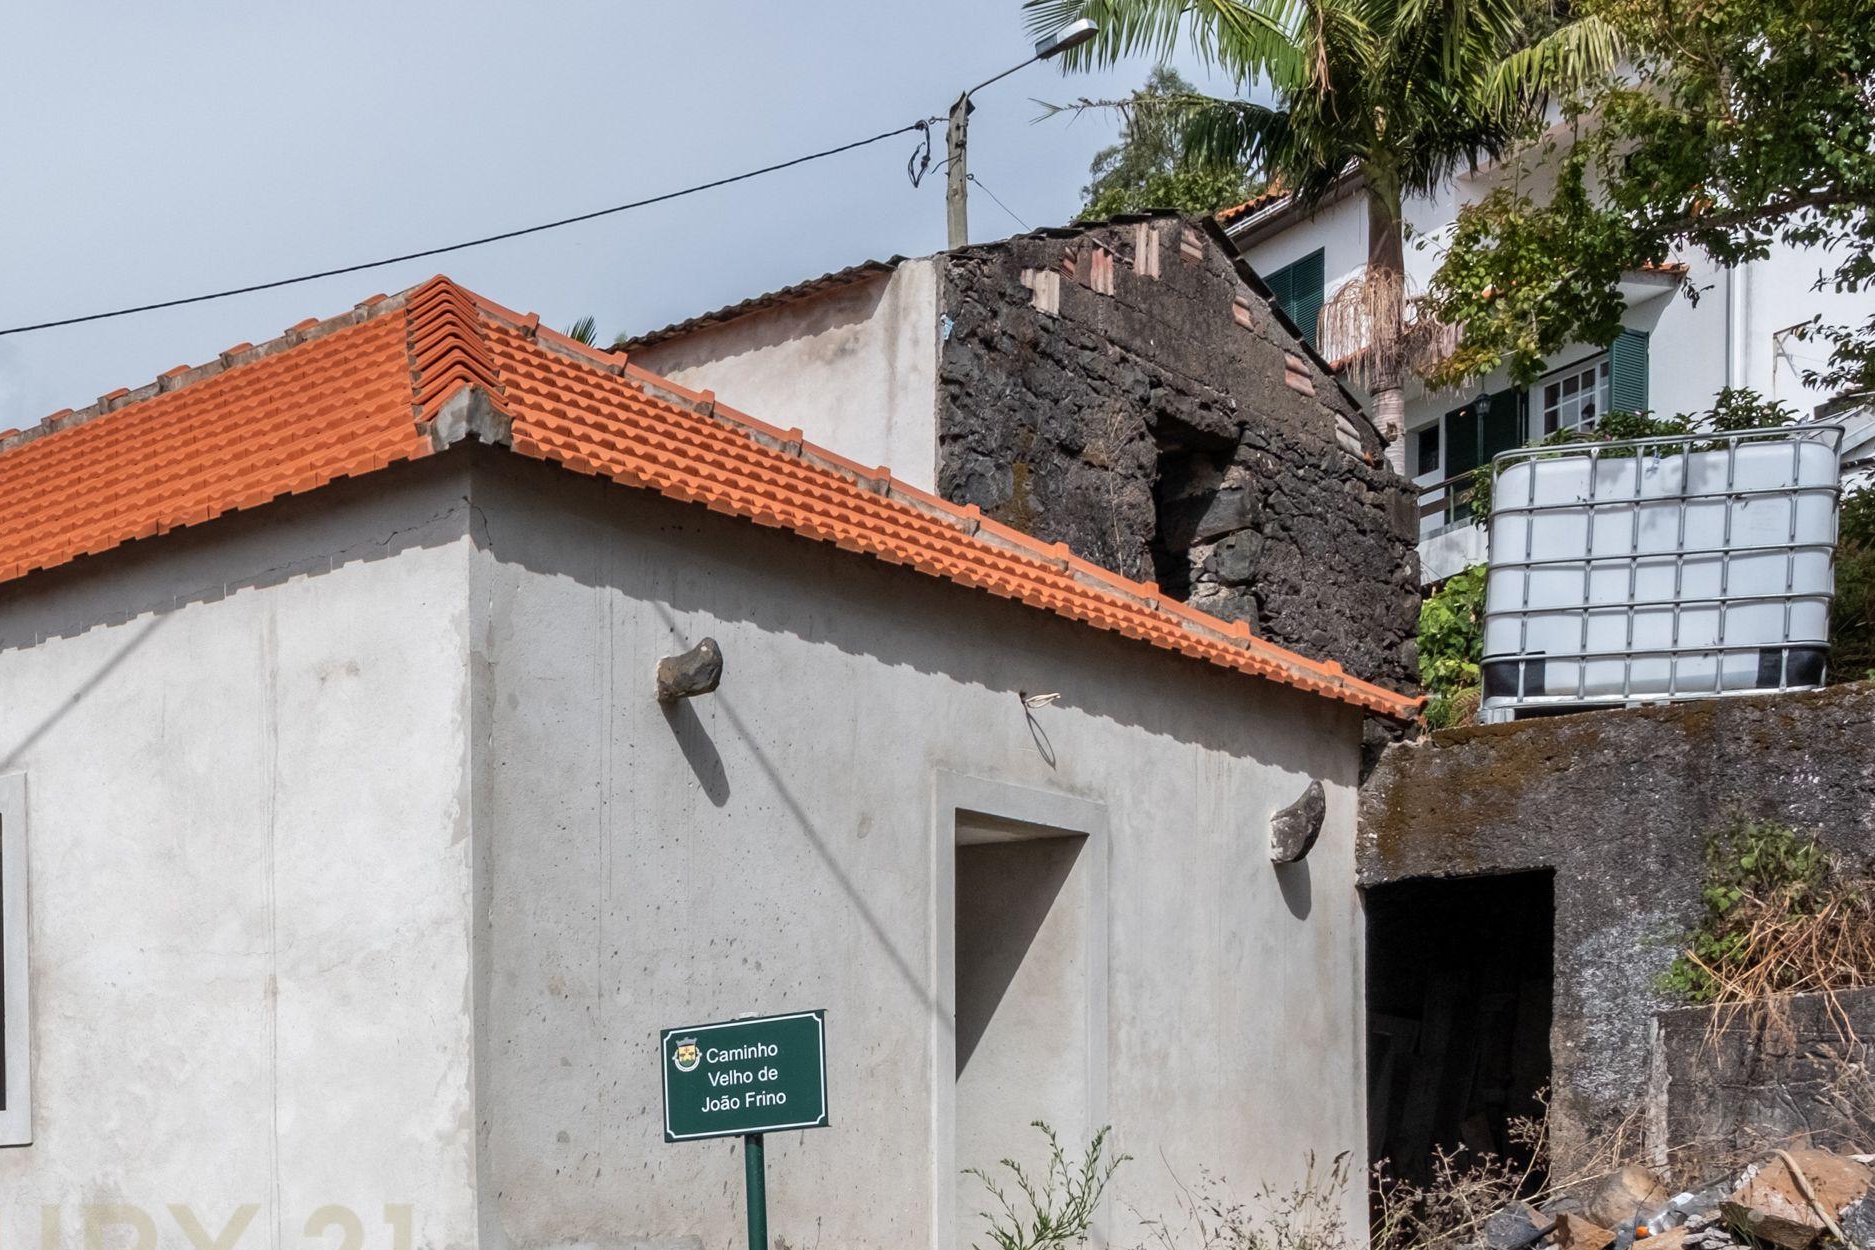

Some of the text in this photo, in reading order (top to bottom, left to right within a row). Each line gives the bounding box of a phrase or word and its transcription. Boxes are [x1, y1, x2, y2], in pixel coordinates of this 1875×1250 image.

[706, 1042, 778, 1064] Caminho
[707, 1066, 778, 1087] Velho de
[701, 1090, 787, 1113] João Frino
